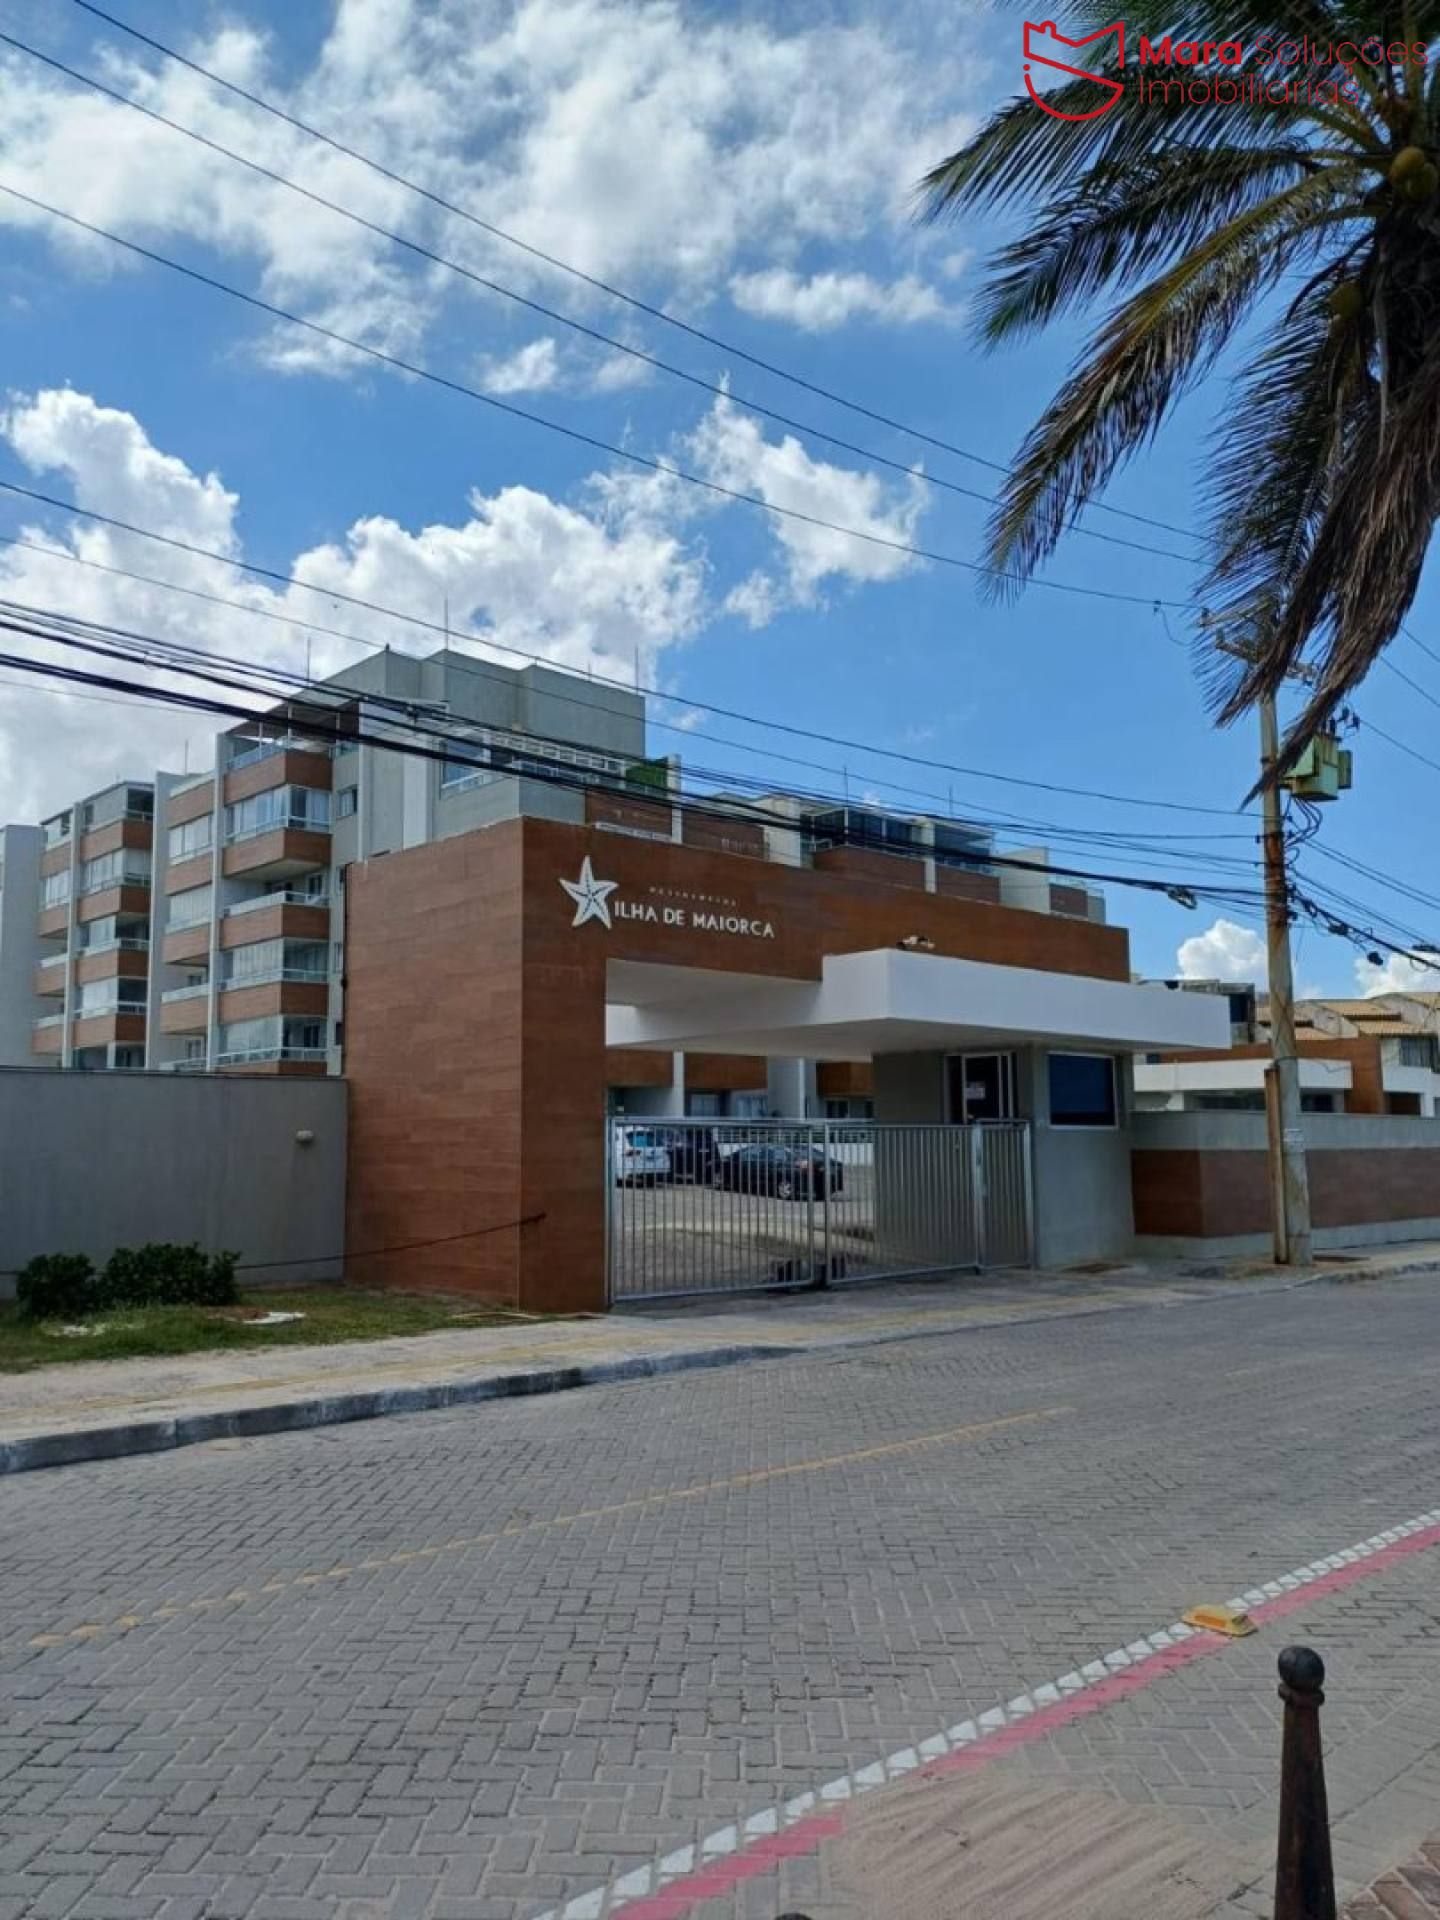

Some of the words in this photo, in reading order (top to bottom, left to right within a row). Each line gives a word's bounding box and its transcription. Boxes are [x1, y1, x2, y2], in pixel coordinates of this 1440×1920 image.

[614, 900, 658, 923] ILHA
[663, 907, 686, 926] DE
[692, 911, 775, 939] MAIORCA
